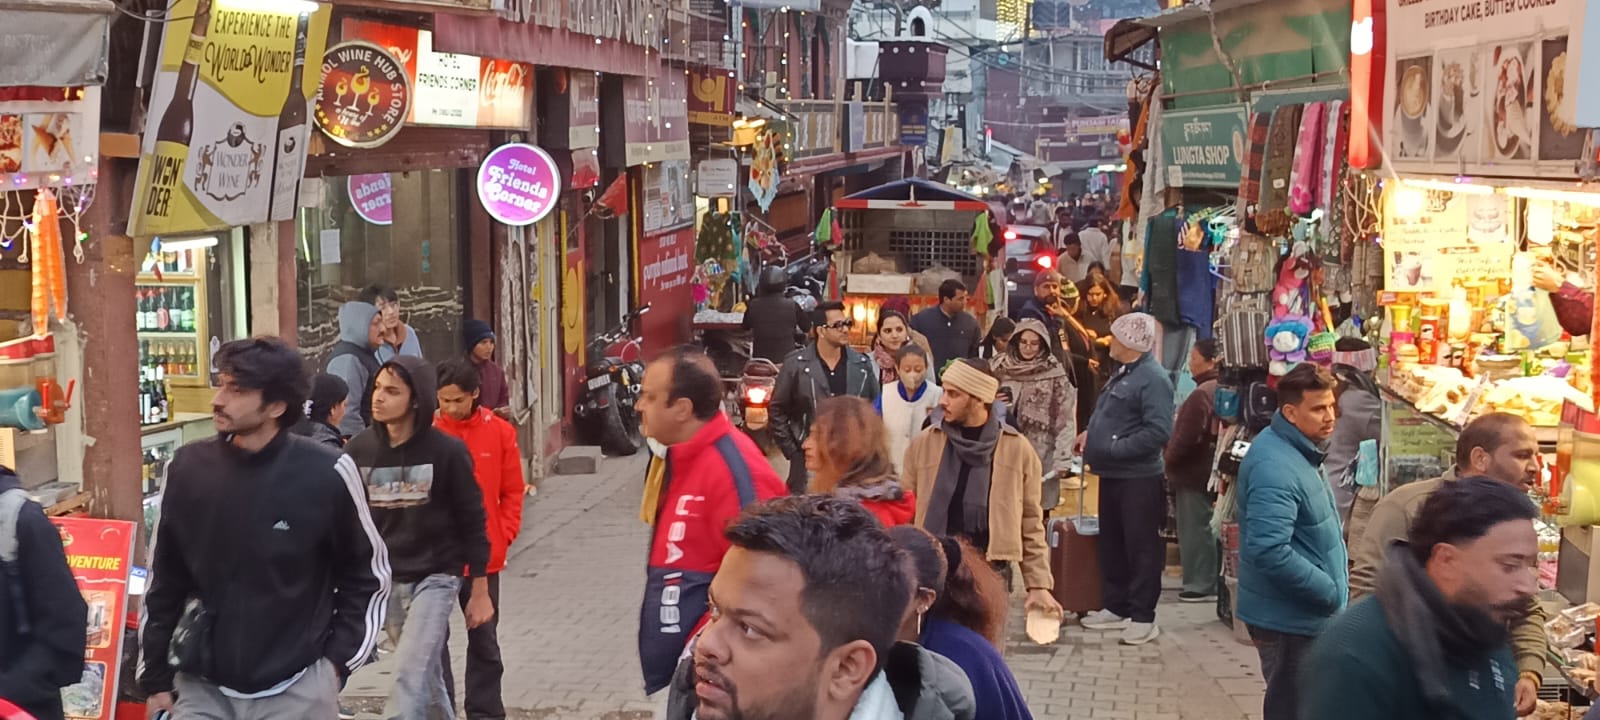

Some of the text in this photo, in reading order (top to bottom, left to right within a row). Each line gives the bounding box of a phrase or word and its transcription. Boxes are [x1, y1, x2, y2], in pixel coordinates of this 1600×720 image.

[215, 10, 293, 39] EXPERIENCE THE
[1424, 7, 1460, 29] BIRTHDAY
[1460, 2, 1483, 22] CAKE,
[1484, 0, 1516, 17] BUTTER
[204, 41, 248, 82] WORLD
[248, 44, 292, 83] WONDER
[338, 48, 372, 63] WINE
[374, 55, 398, 81] HUB
[418, 72, 477, 92] FRIENDS CORNER
[383, 82, 403, 125] STORE
[215, 151, 248, 168] WONDER
[508, 158, 537, 176] Hotel
[1172, 145, 1230, 165] LUNGTA SHOP
[488, 165, 548, 199] Friends
[484, 181, 542, 213] Corner
[66, 555, 121, 570] VENTURE
